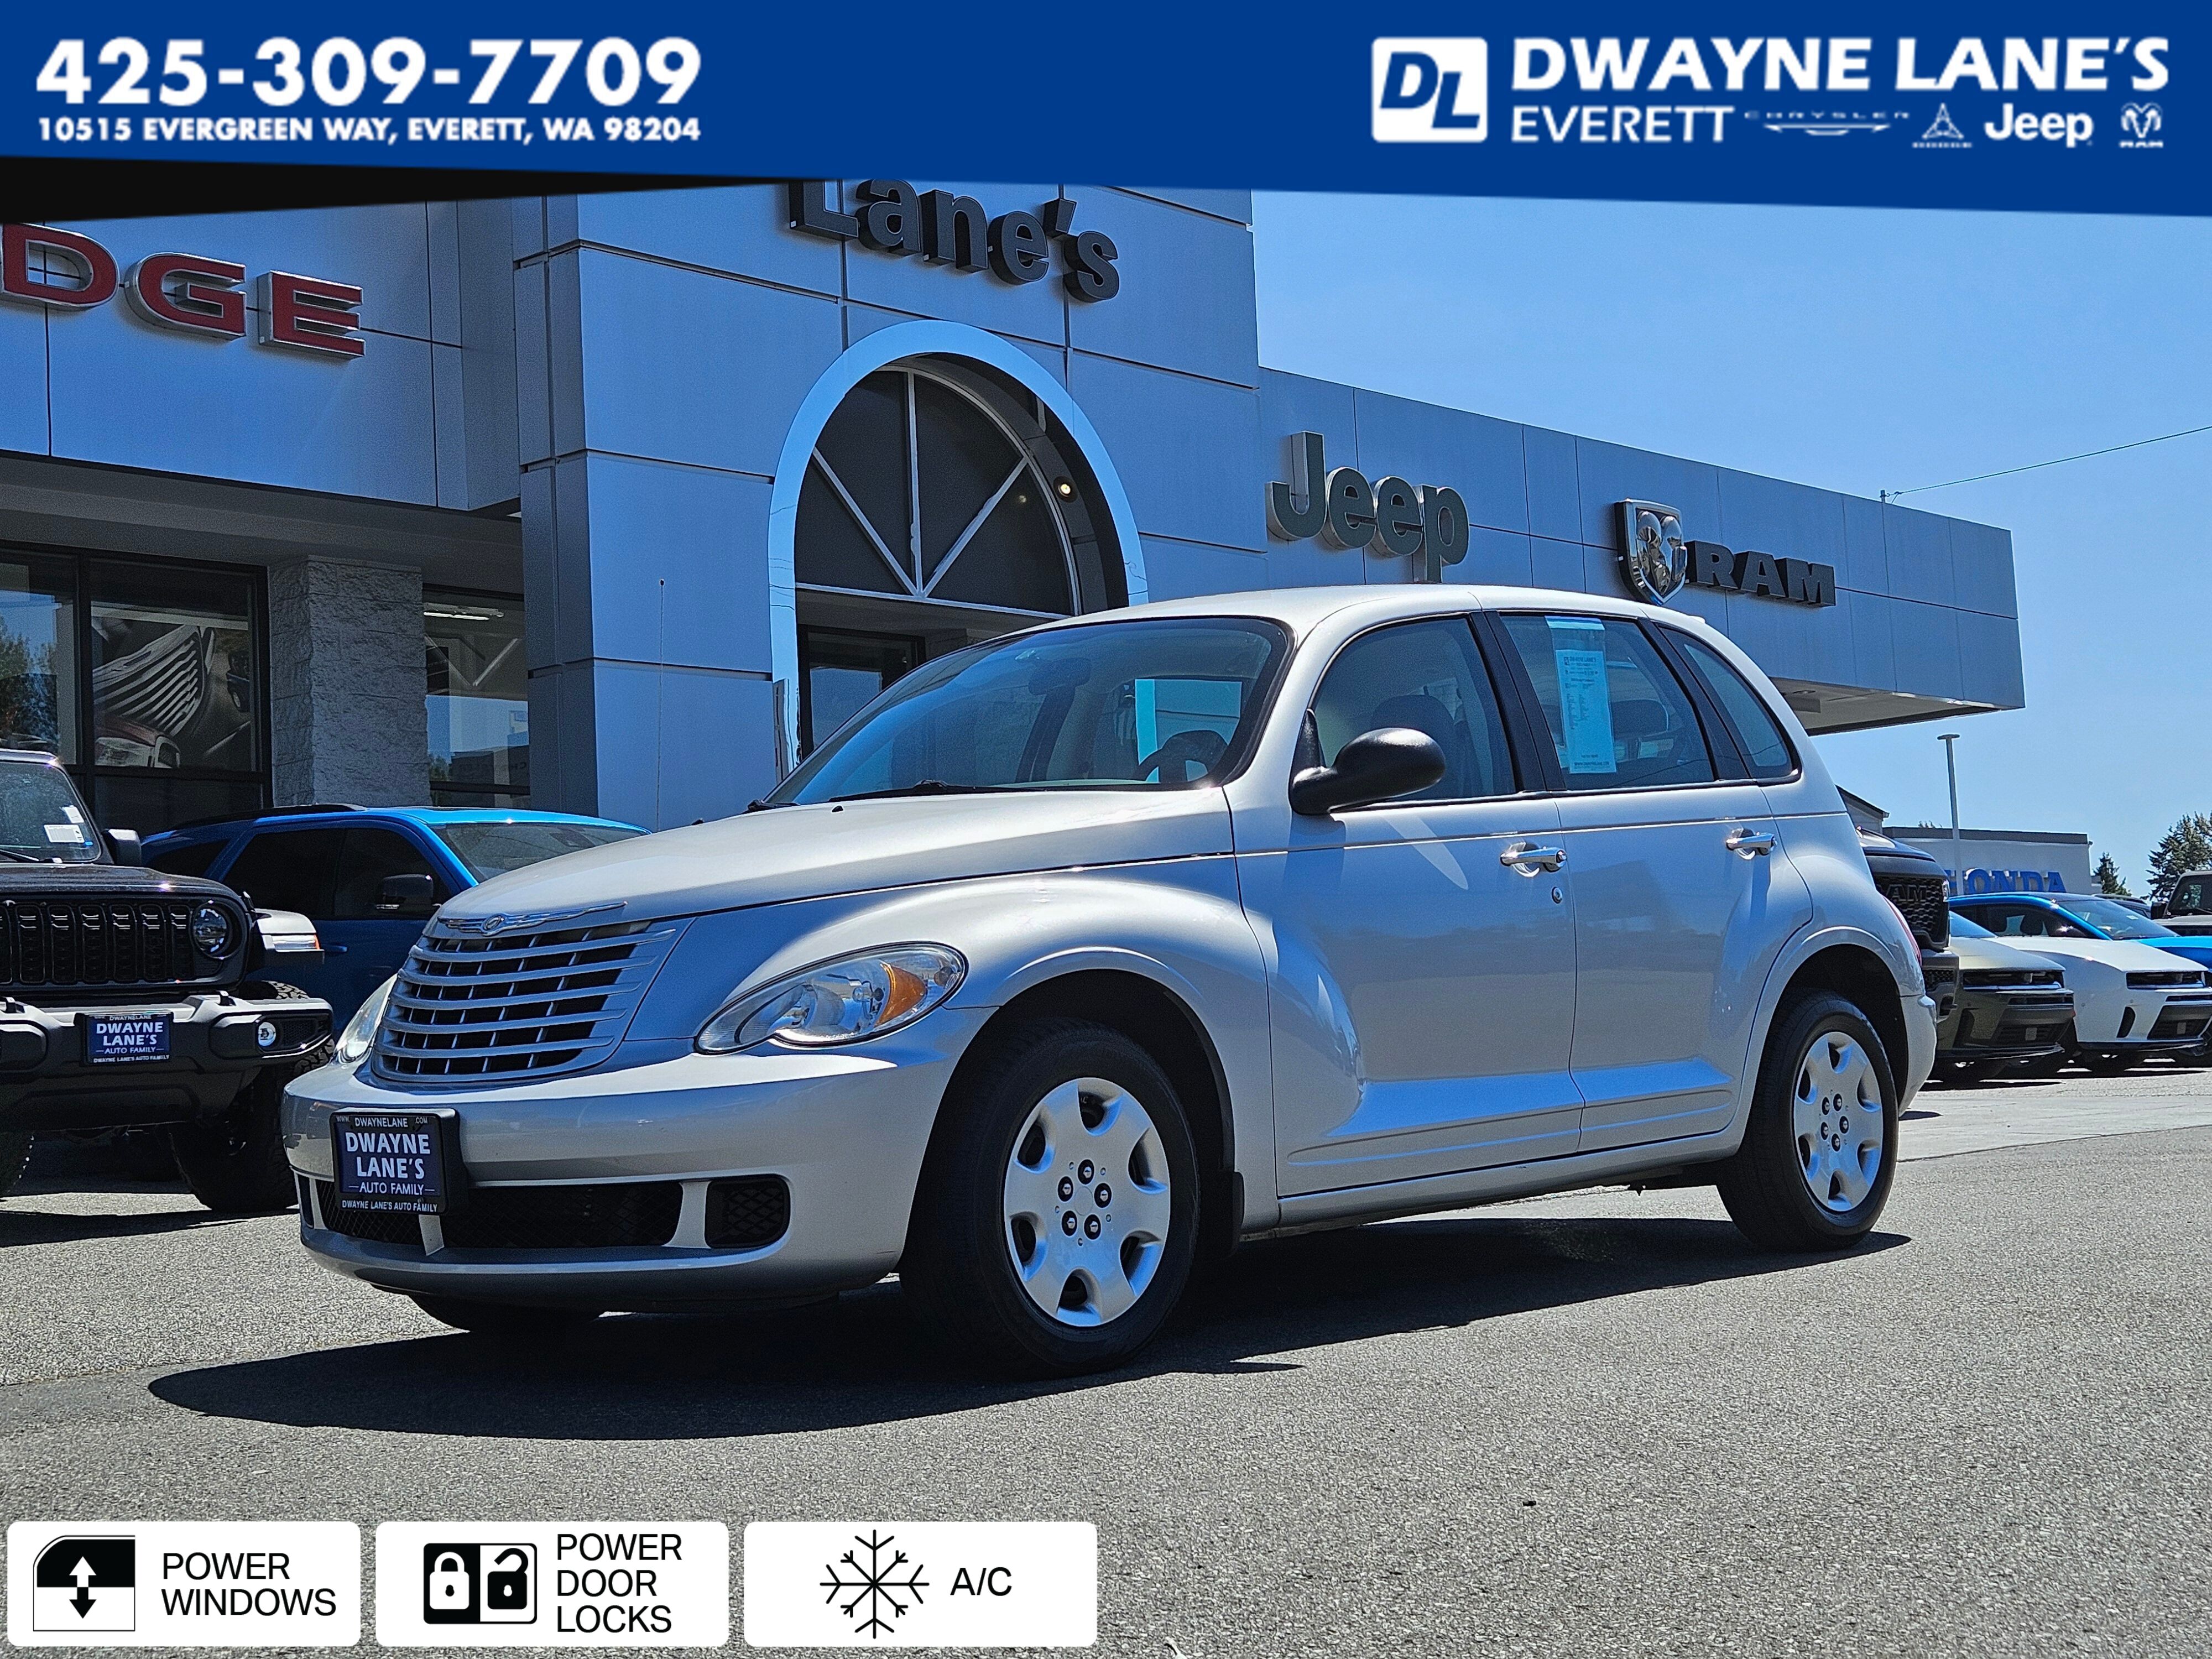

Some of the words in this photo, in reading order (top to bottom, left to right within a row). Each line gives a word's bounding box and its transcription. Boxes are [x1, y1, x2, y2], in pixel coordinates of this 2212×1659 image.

[789, 180, 1120, 302] Lane's
[1265, 430, 1469, 583] Jeep
[1682, 540, 1836, 606] RAM
[96, 1022, 164, 1034] DWAYNE
[103, 1034, 157, 1046] LANE'S
[354, 1118, 408, 1128] DWAYNELANE
[345, 1132, 431, 1154] DWAYNE
[356, 1156, 425, 1180] LANE'S
[359, 1182, 387, 1194] AUTO
[390, 1183, 424, 1196] FAMILY
[342, 1200, 369, 1209] DWAYNE
[371, 1201, 393, 1210] LANE'S
[394, 1202, 411, 1211] AUTO
[413, 1203, 437, 1213] FAMILY
